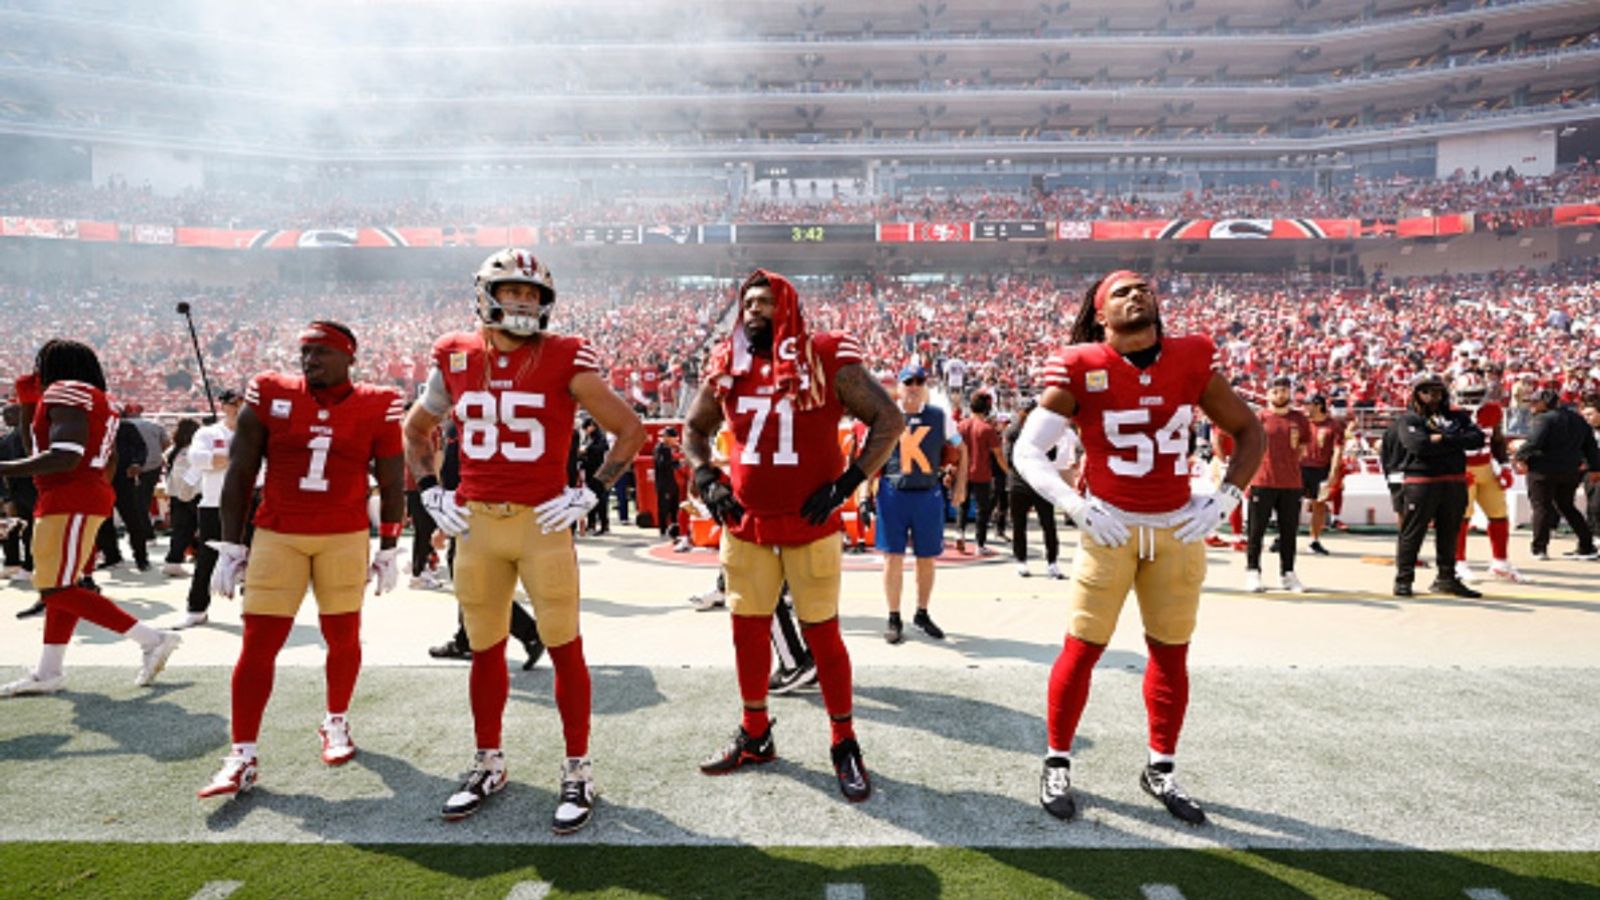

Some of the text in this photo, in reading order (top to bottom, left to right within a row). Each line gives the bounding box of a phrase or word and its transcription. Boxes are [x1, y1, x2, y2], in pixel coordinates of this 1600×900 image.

[791, 226, 824, 241] 3:42
[455, 391, 546, 462] 85
[735, 396, 799, 465] 71
[899, 425, 933, 475] K
[1102, 404, 1194, 478] 54
[298, 435, 333, 492] 1
